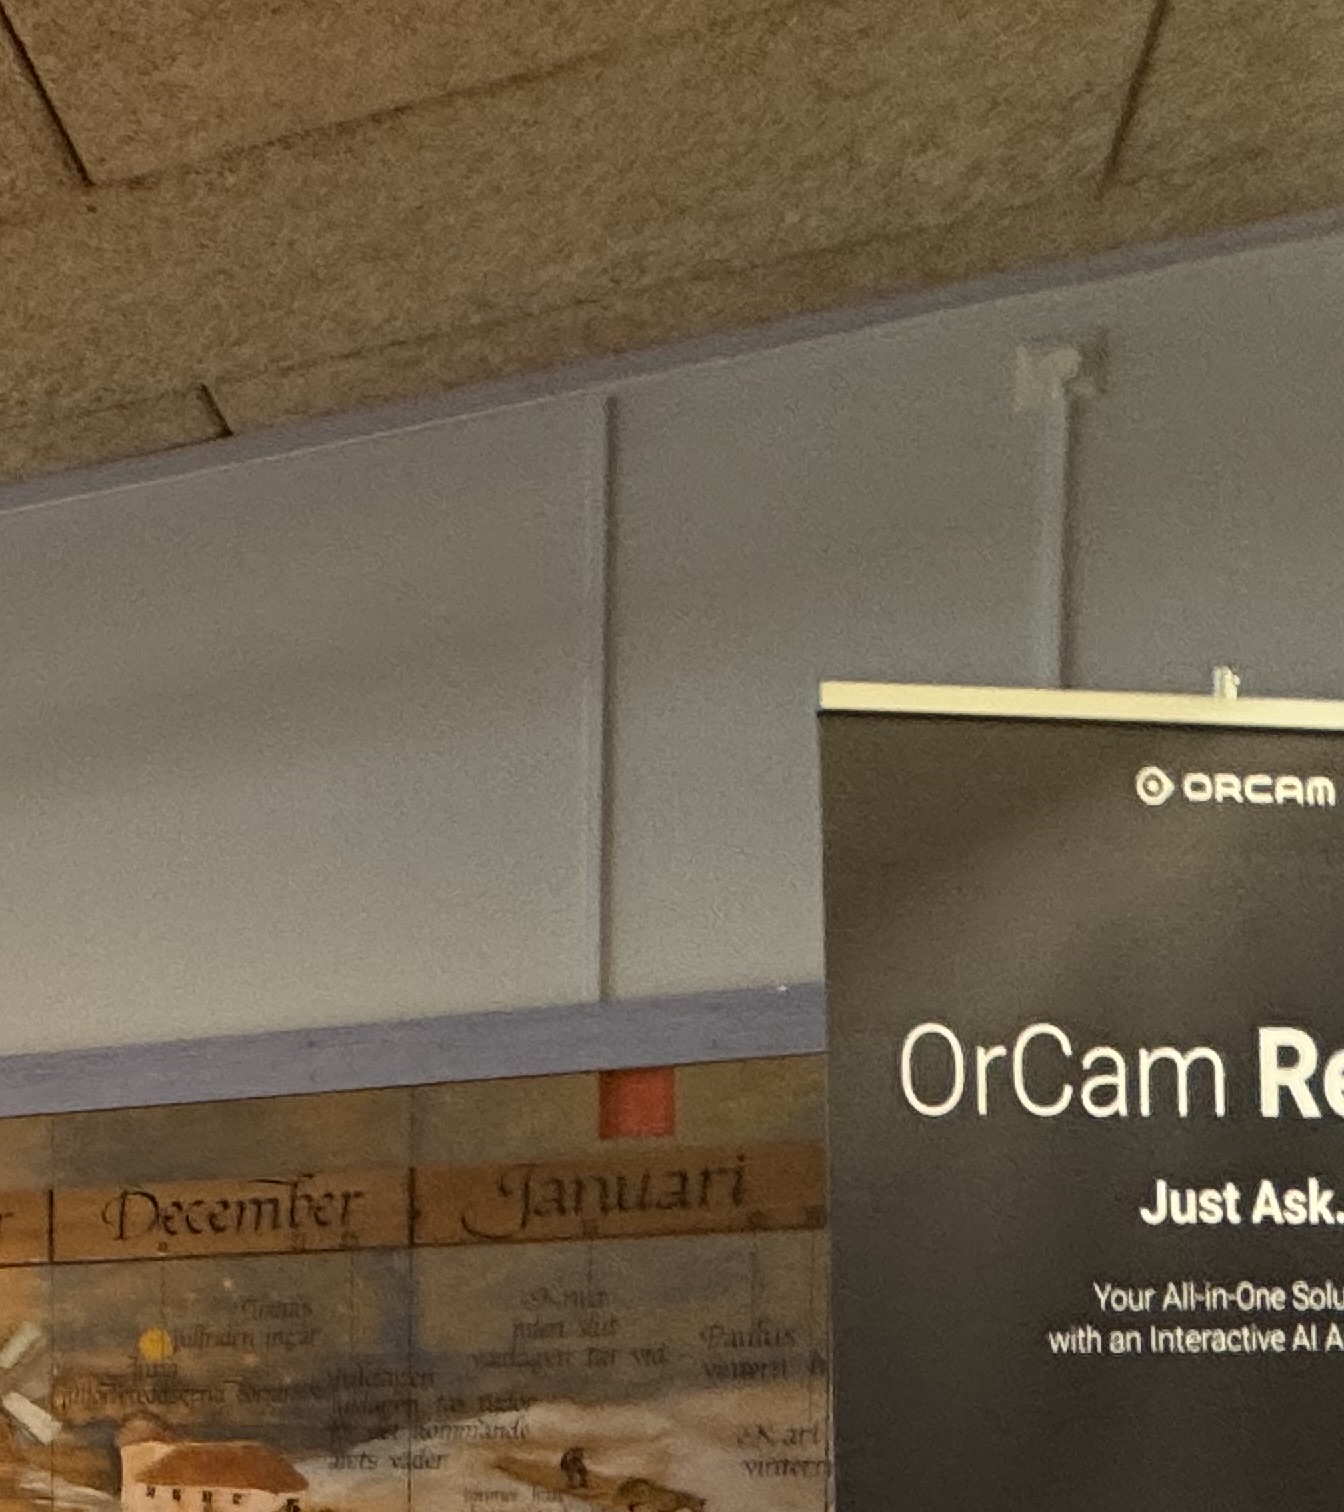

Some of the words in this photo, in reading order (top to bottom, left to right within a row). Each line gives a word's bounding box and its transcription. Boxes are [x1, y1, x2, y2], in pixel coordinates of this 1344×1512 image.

[1182, 772, 1336, 807] ORCAM
[900, 1022, 1226, 1118] OrCam
[101, 1172, 366, 1241] December
[1139, 1178, 1242, 1225] Just
[1252, 1177, 1344, 1225] Ask.
[1092, 1281, 1157, 1312] Your
[1162, 1279, 1287, 1312] All-in-One
[1048, 1325, 1102, 1354] with
[1109, 1328, 1142, 1354] an
[1150, 1324, 1286, 1354] Interactive
[1292, 1322, 1318, 1352] AI
